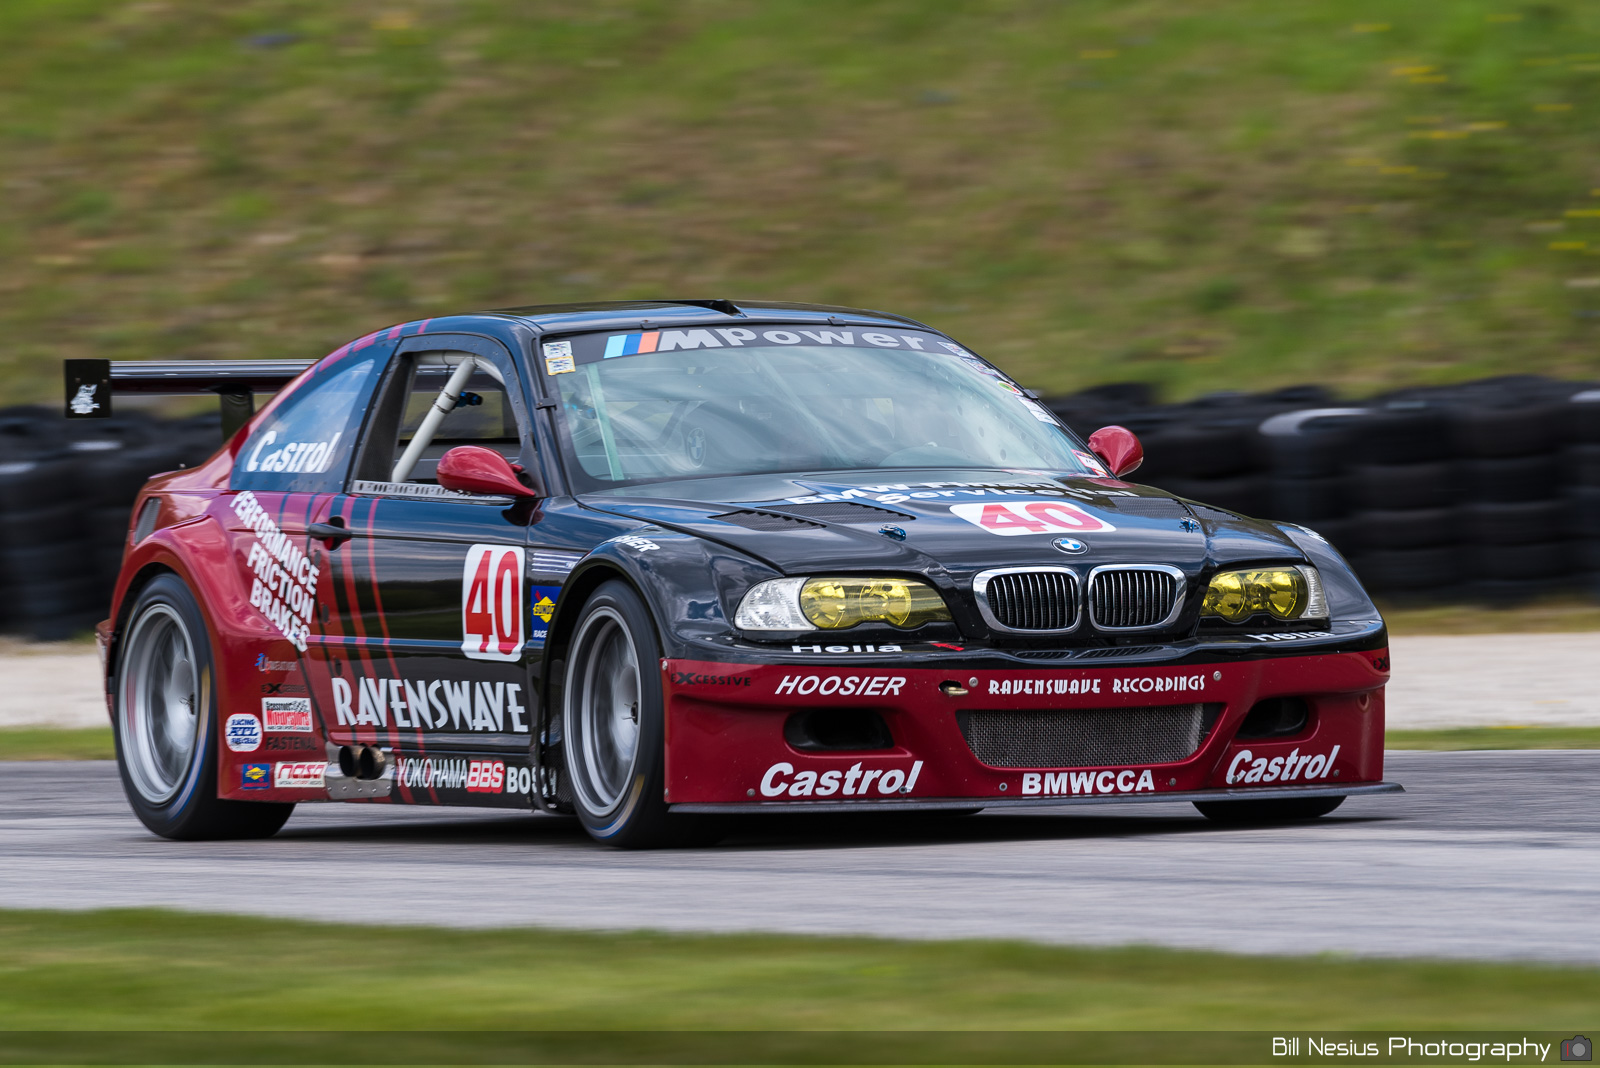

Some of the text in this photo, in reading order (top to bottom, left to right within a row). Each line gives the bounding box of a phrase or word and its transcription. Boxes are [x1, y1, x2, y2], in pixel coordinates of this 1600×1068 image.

[246, 430, 342, 473] Castrol
[785, 484, 910, 504] BMW
[980, 502, 1104, 533] 40
[229, 490, 320, 596] PERFORMANCE
[247, 541, 315, 625] FRICTION
[250, 578, 310, 652] BRAKES
[465, 550, 520, 656] 40
[791, 644, 903, 654] Hella
[671, 672, 751, 687] EXCESSIVE
[774, 675, 907, 696] HOOSIER
[988, 674, 1206, 695] RAVENSWAVE RECORDINGS
[331, 677, 528, 732] RAVENSWAVE
[397, 757, 467, 789] YOKOHAMA
[468, 761, 505, 788] BBS
[760, 760, 924, 797] Castrol
[1225, 744, 1341, 785] Castrol
[1021, 770, 1155, 795] BMWCCA
